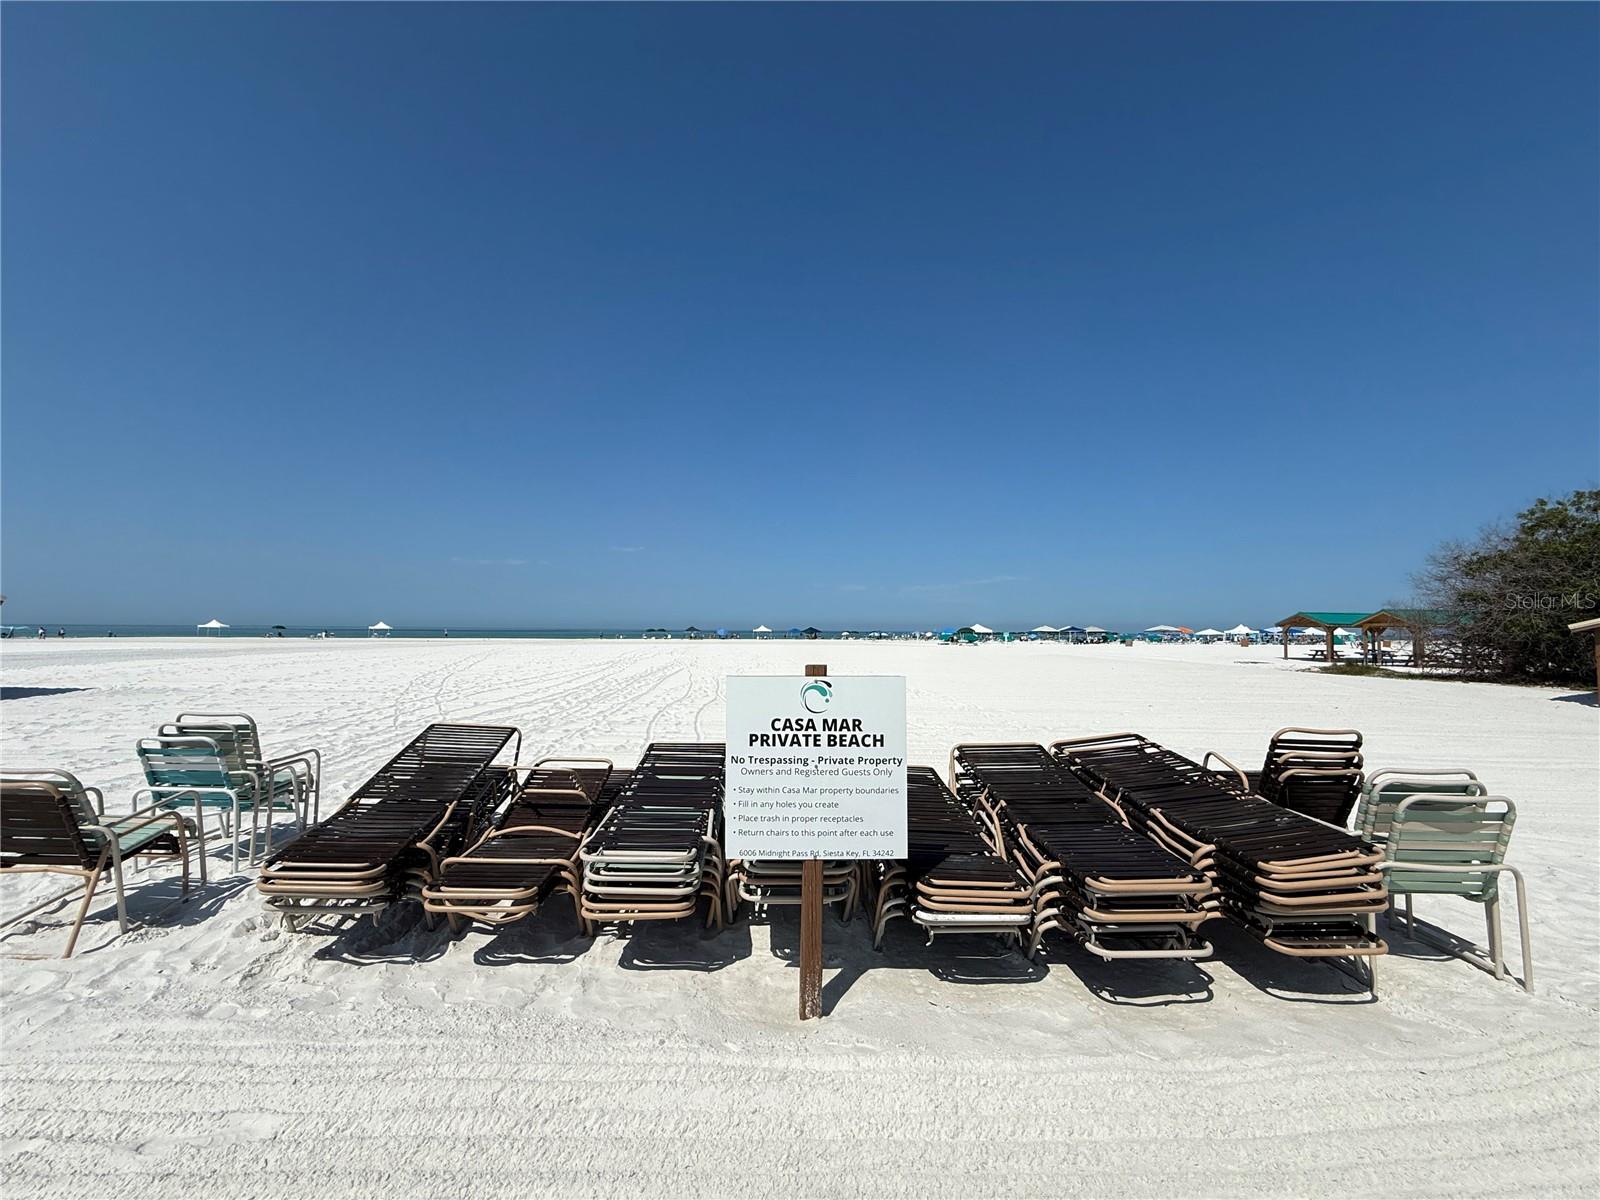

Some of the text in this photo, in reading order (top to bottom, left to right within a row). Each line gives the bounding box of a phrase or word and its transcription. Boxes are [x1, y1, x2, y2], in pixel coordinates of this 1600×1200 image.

[771, 718, 863, 732] CASA MAR
[749, 734, 884, 747] PRIVATE BEACH
[731, 756, 745, 765] No
[748, 756, 809, 766] Trespassing
[818, 756, 854, 765] Private
[858, 756, 903, 766] Property
[741, 767, 893, 777] Owners and Registered Guests Only
[738, 786, 755, 795] Stay
[756, 786, 780, 794] within
[820, 786, 854, 796] property
[855, 786, 899, 795] boundaries
[760, 802, 774, 810] any
[776, 800, 796, 808] holes
[798, 802, 813, 810] you
[791, 816, 818, 824] proper
[820, 815, 864, 824] receptacles
[738, 829, 764, 837] Return
[766, 829, 789, 837] chairs
[801, 829, 816, 837] this
[817, 829, 838, 838] point
[839, 829, 858, 837] after
[859, 829, 879, 837] each
[758, 849, 790, 858] Midnight
[846, 850, 861, 858] Key,
